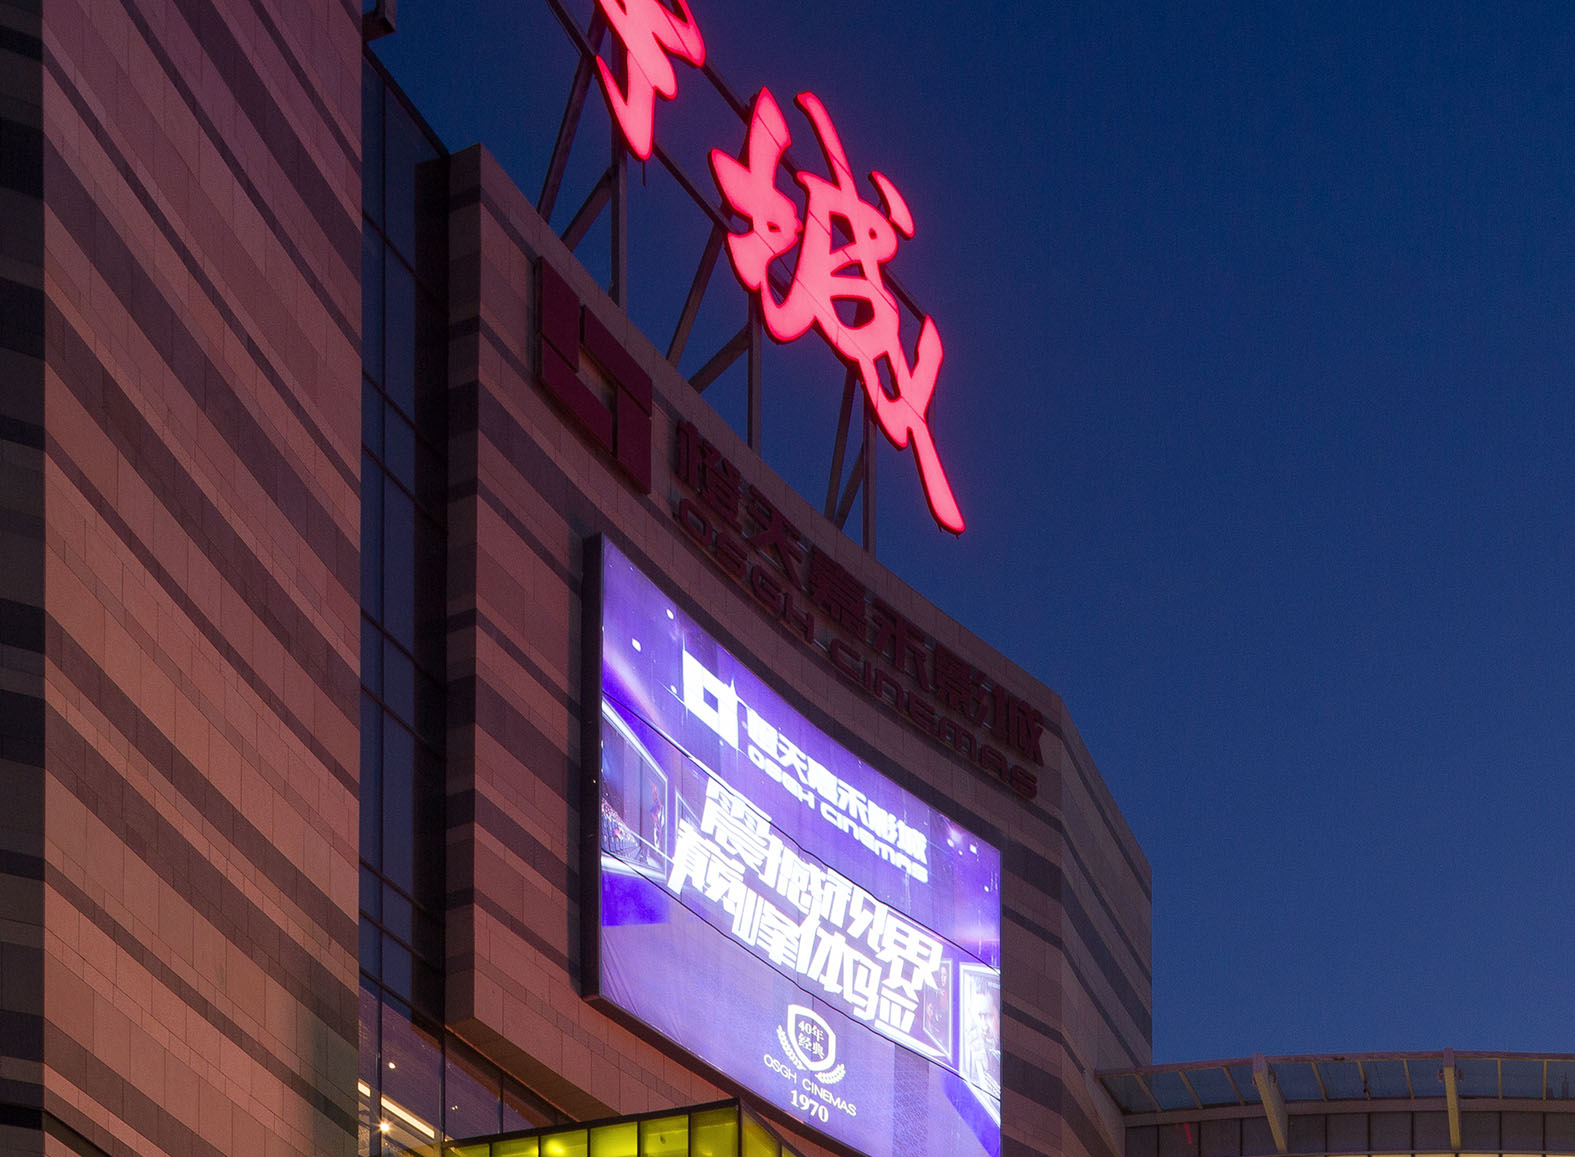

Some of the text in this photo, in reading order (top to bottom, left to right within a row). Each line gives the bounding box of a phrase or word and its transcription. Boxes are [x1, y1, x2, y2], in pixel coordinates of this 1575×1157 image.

[798, 1020, 825, 1040] 40年
[763, 1054, 857, 1117] OSGH CINEMAS
[790, 1089, 829, 1123] 1970
